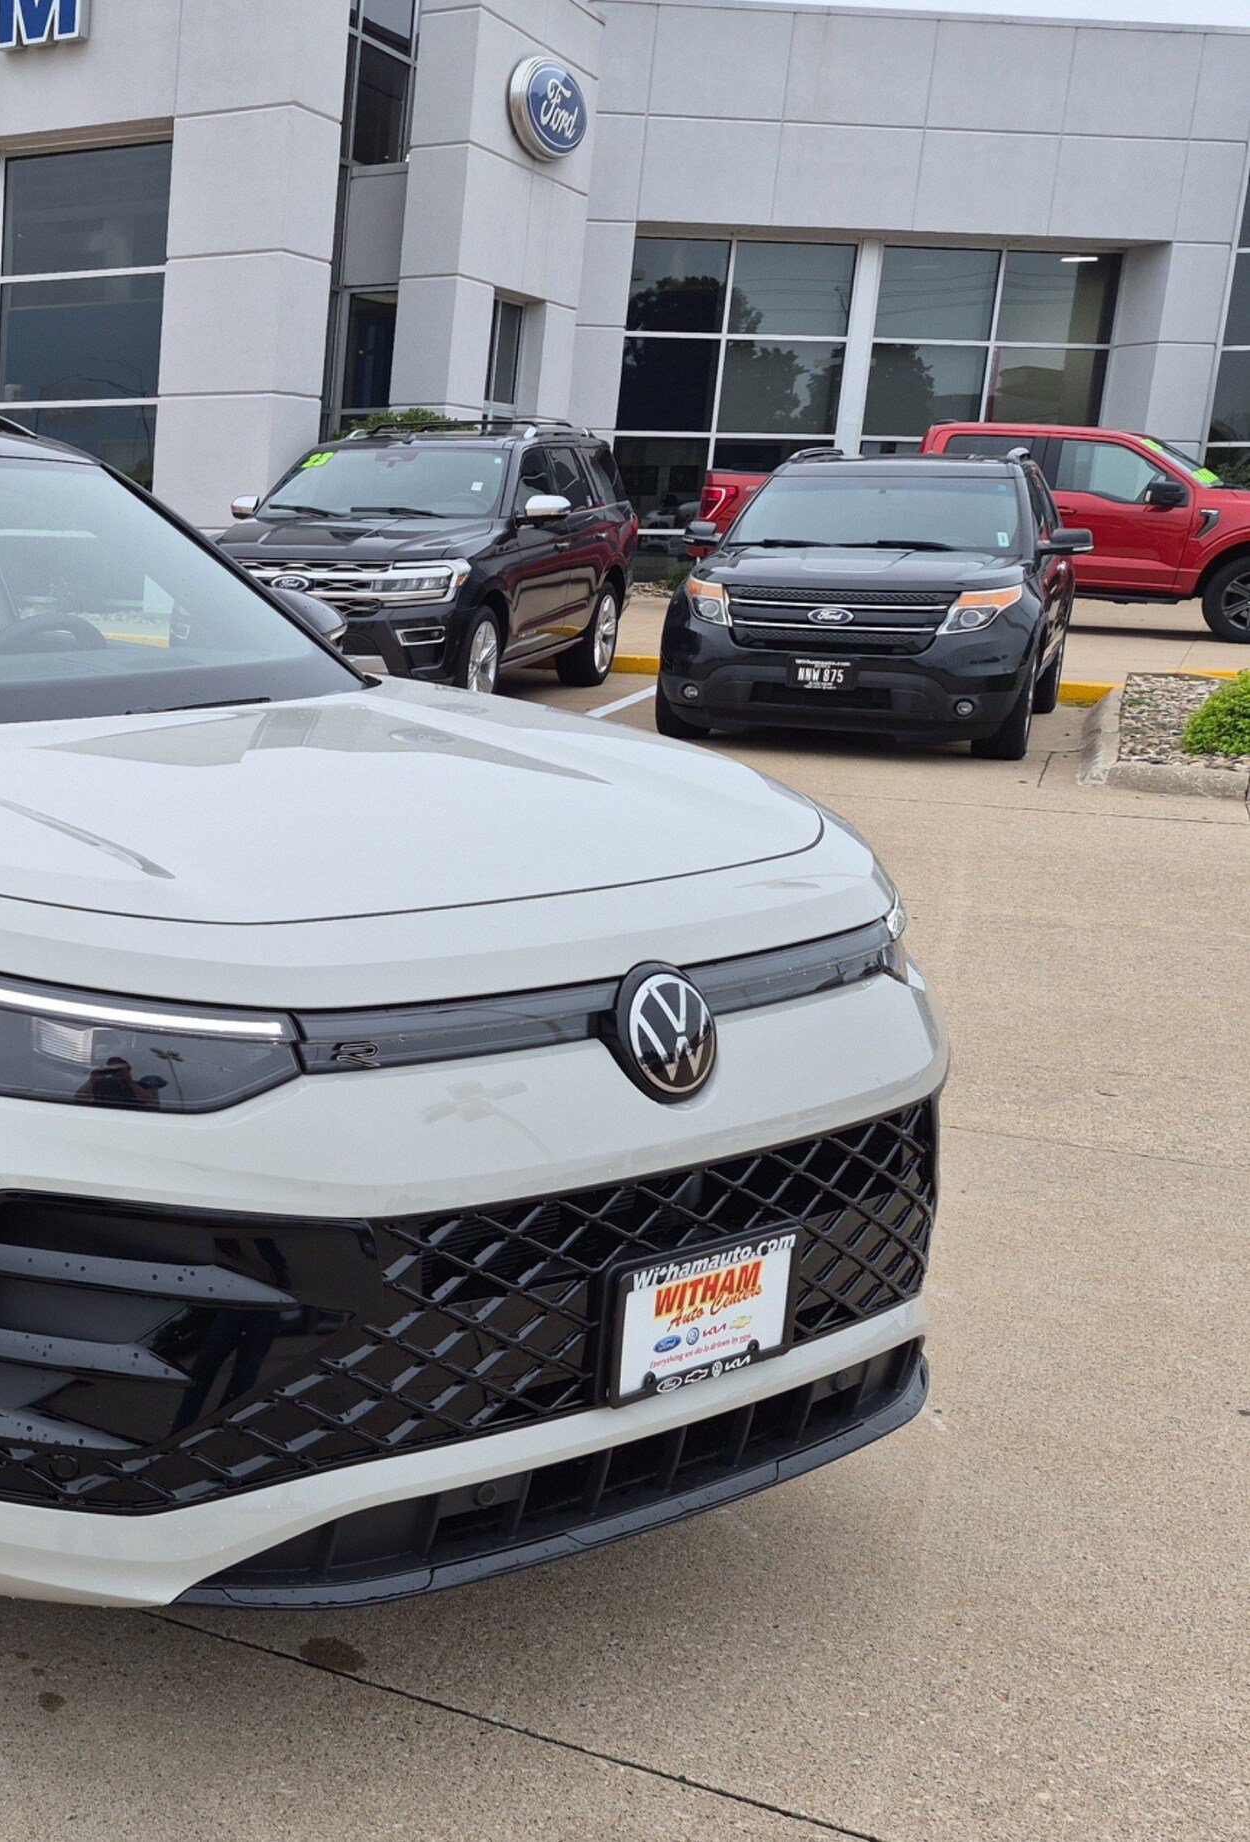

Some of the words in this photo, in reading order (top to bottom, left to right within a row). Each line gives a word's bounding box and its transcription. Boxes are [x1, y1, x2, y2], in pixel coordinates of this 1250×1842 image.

[540, 78, 579, 139] Ford
[816, 608, 843, 621] Ford
[823, 668, 844, 683] 875
[654, 1260, 764, 1318] WITHAM
[667, 1307, 705, 1333] Auto
